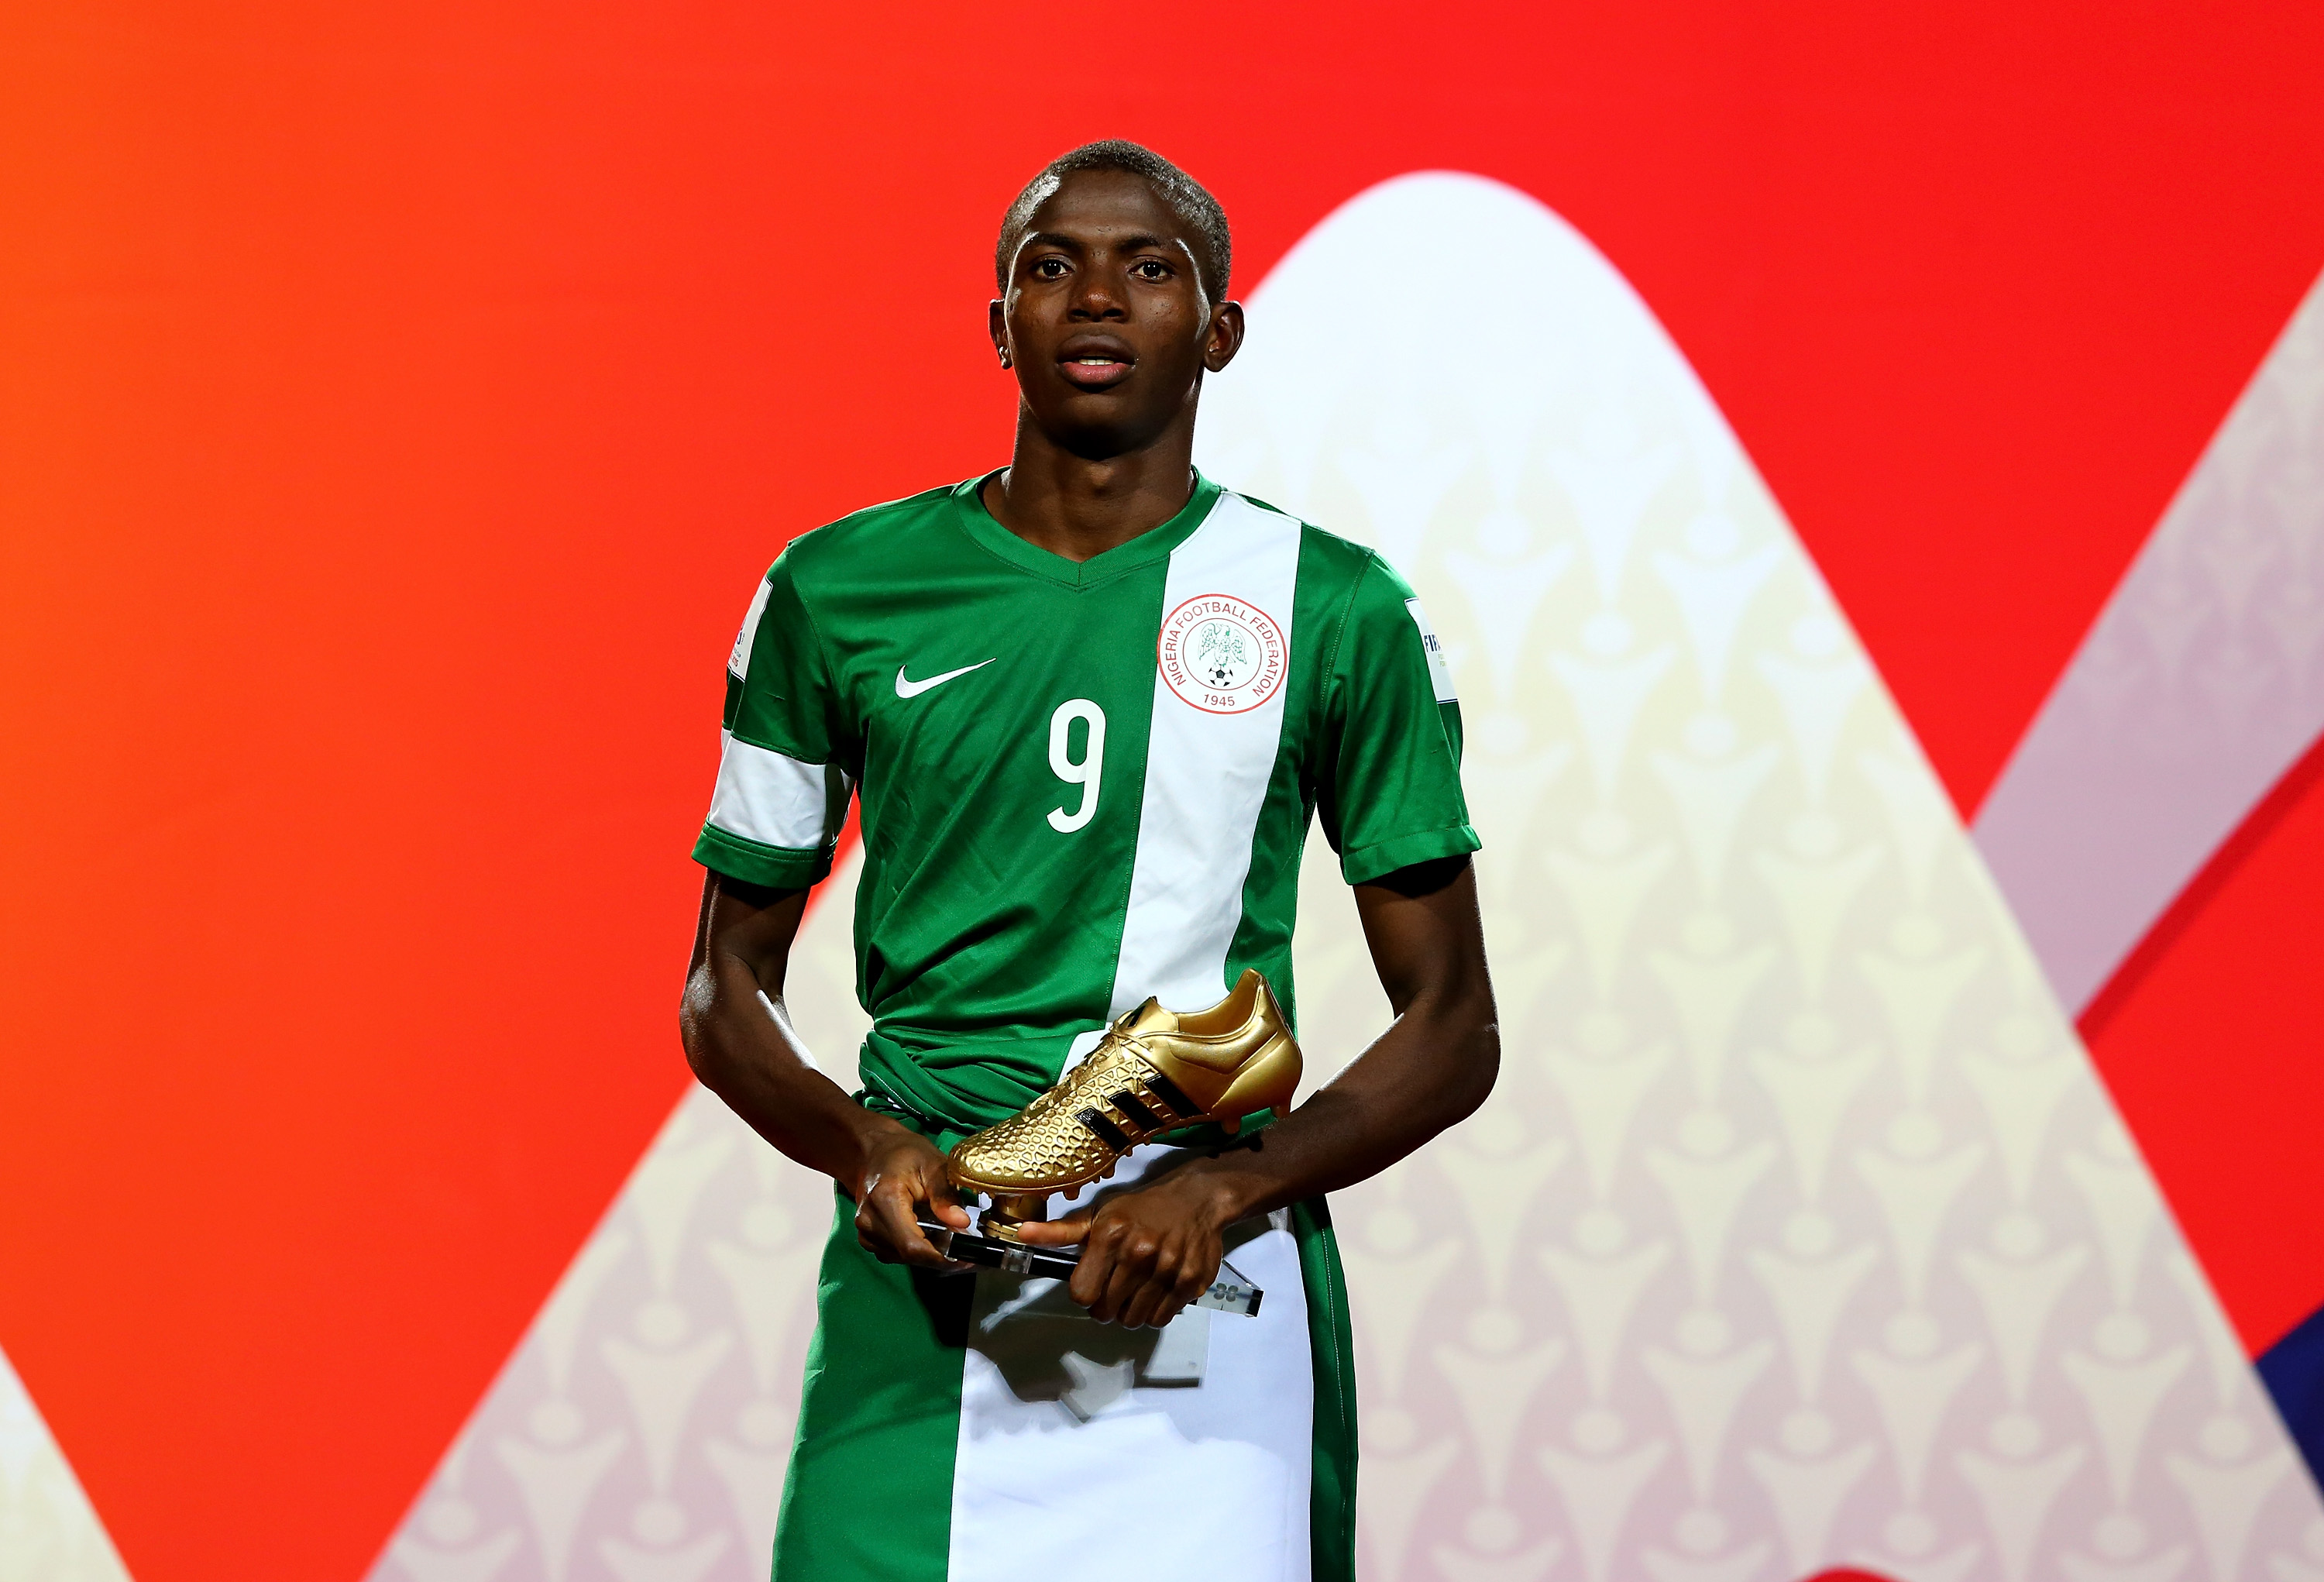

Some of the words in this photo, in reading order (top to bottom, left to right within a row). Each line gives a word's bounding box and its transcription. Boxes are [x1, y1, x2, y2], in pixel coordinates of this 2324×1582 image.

[1175, 602, 1246, 628] FOOTBALL
[1165, 630, 1186, 686] NIGERIA
[1249, 616, 1279, 697] FEDERATION
[1203, 693, 1235, 707] 1945
[1047, 698, 1107, 834] 9
